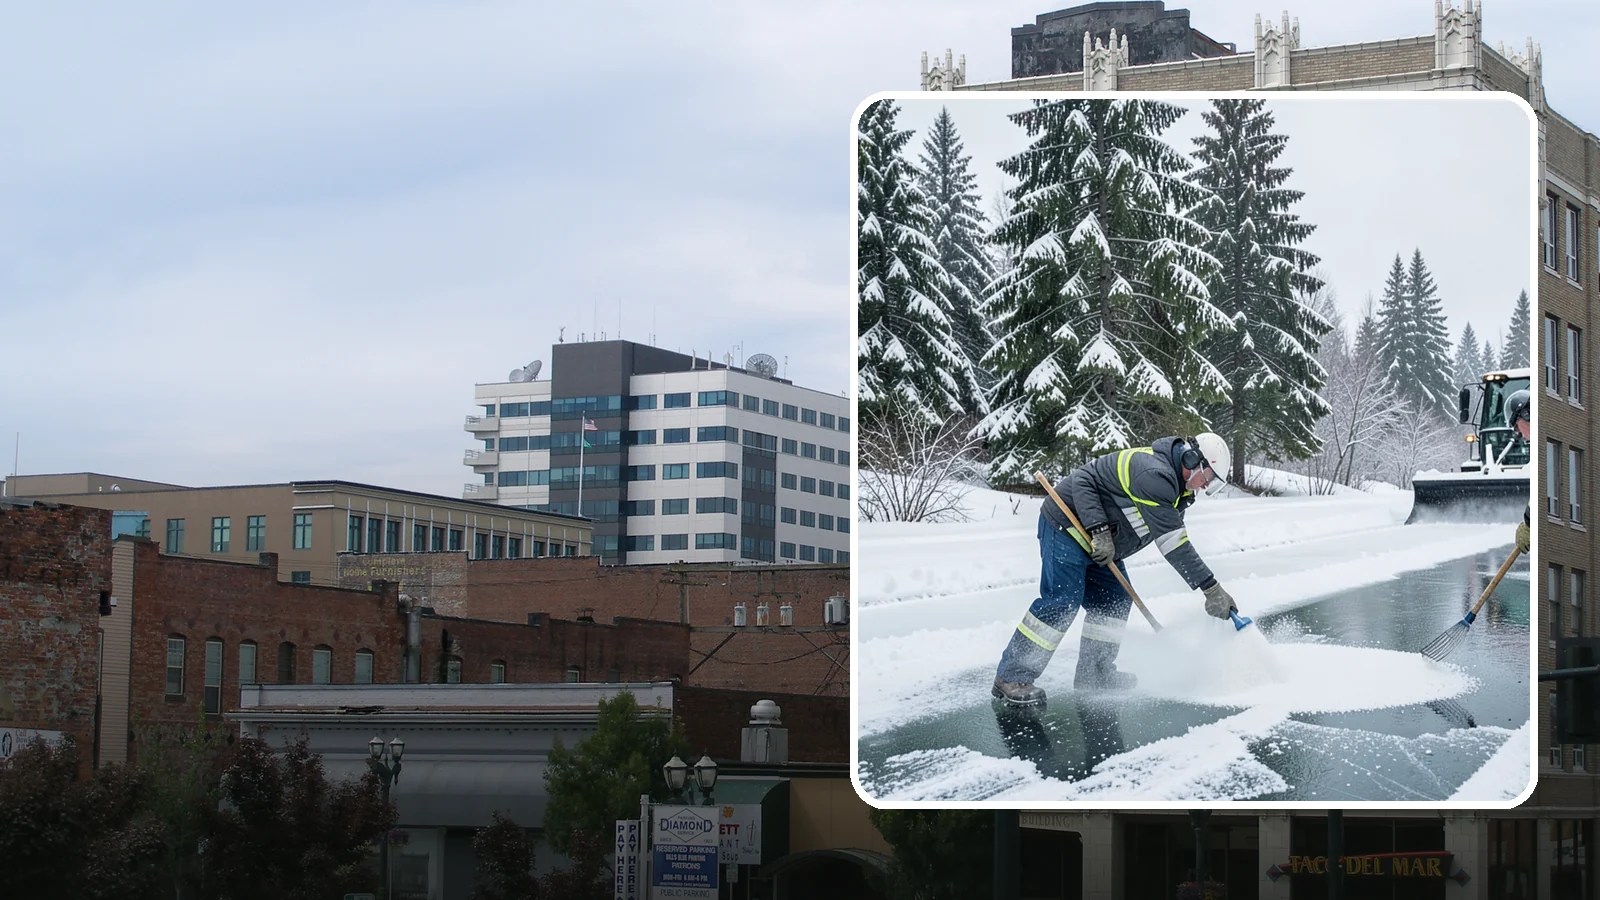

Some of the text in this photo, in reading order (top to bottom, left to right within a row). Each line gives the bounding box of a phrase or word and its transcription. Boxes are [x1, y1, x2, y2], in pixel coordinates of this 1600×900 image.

[343, 566, 427, 577] Home Furnishers
[660, 818, 713, 833] DIAMOND
[1022, 815, 1070, 828] BUILDING
[655, 845, 716, 854] RESERVED PARKING
[721, 851, 739, 863] Soup
[671, 862, 701, 870] PATRONS
[1346, 856, 1385, 876] DEL
[1392, 857, 1443, 877] MAR
[660, 888, 710, 898] PUBLIC PARKING
